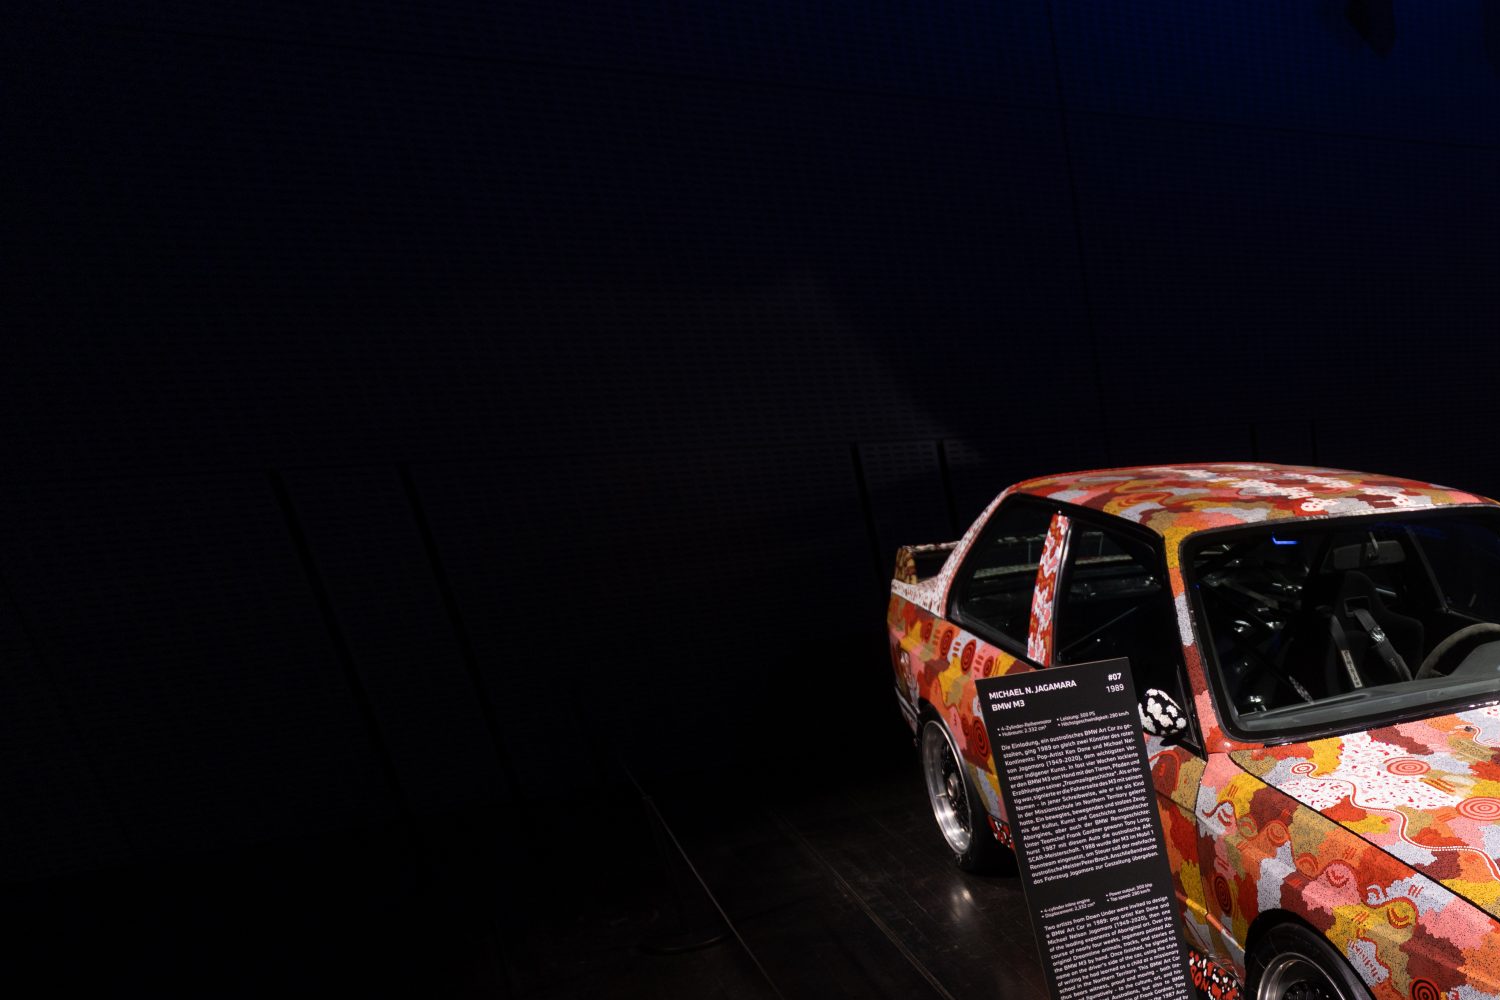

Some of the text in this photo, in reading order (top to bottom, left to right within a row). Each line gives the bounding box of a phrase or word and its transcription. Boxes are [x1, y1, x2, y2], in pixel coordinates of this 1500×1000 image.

[1108, 673, 1122, 681] #07
[989, 688, 1024, 700] MICHAEL
[1035, 680, 1077, 692] JAGAMARA
[1106, 684, 1125, 692] 1989
[992, 700, 1025, 711] BMW M3
